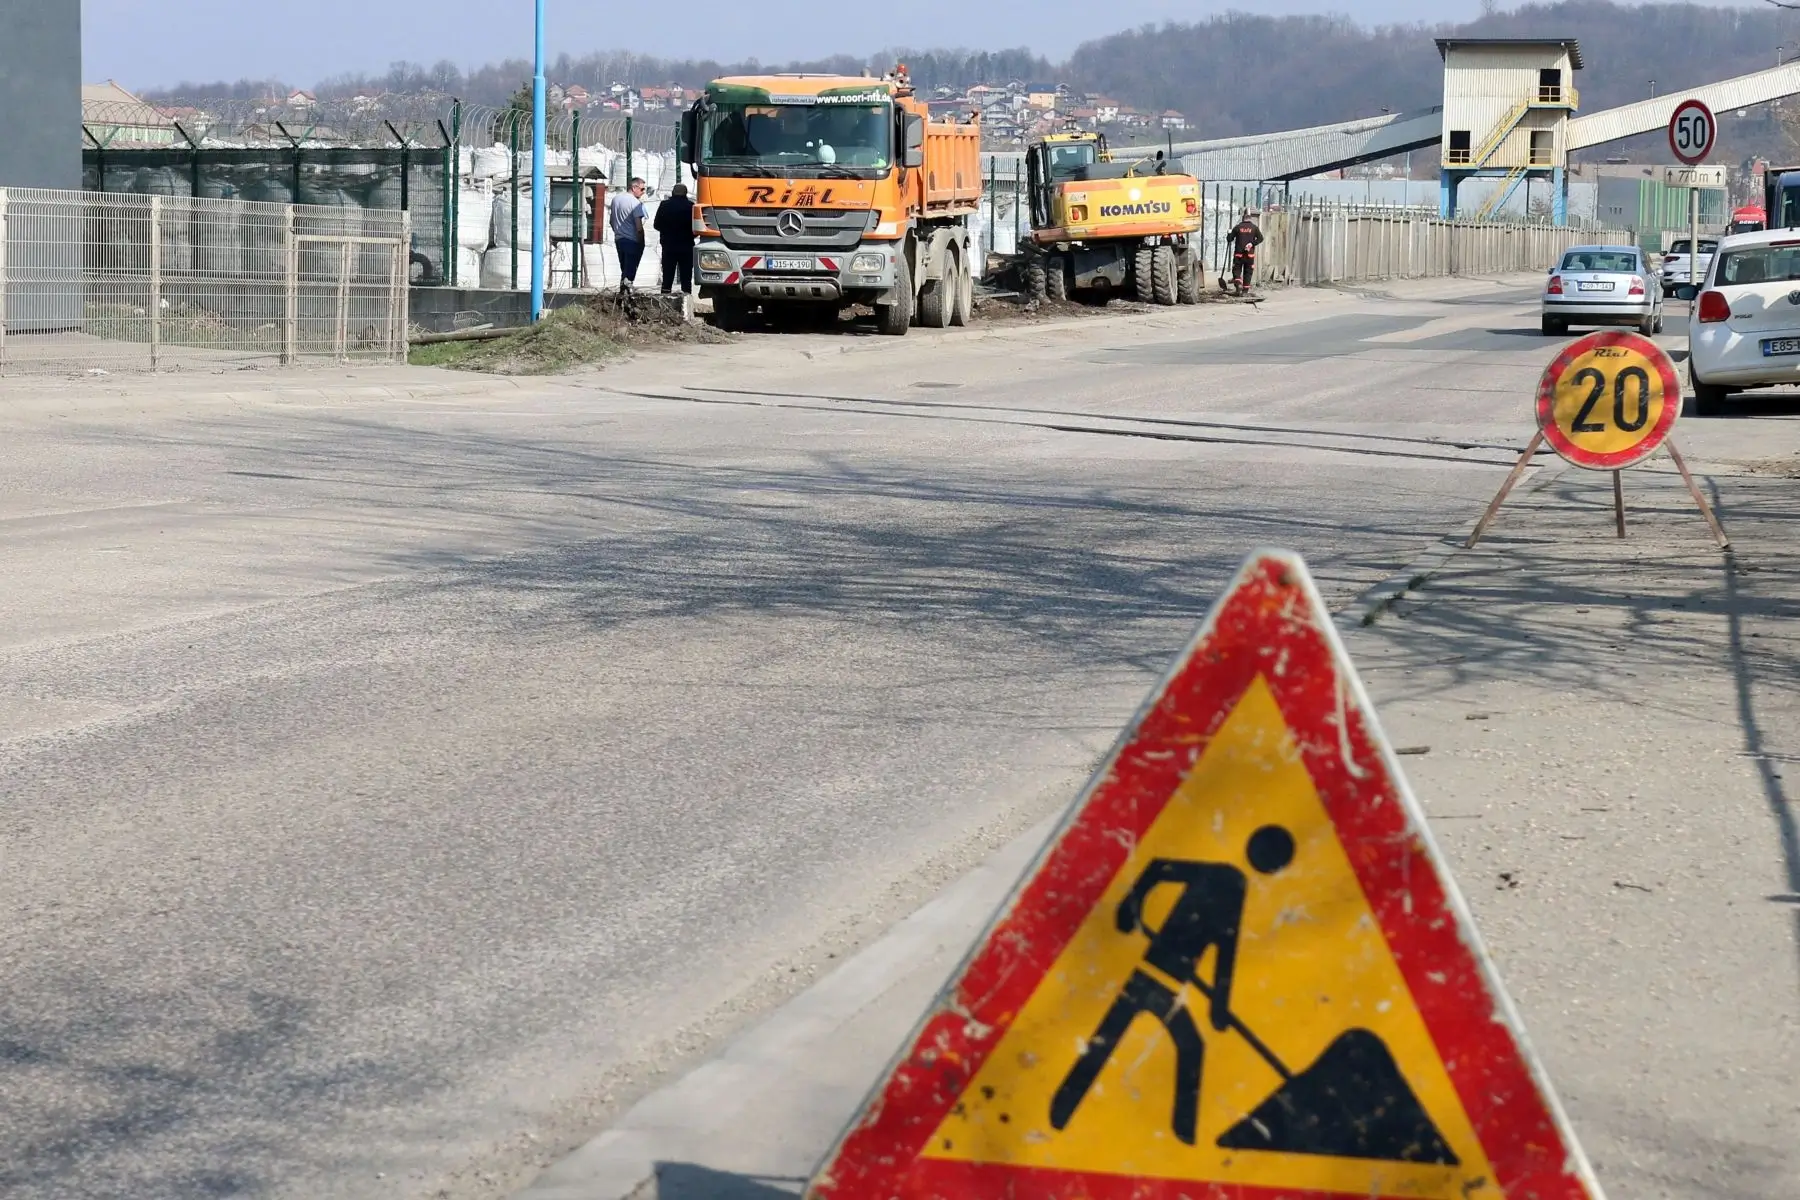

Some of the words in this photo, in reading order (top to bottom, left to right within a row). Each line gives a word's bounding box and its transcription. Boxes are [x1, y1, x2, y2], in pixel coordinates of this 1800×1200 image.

[1679, 116, 1705, 149] 50
[1678, 170, 1697, 182] 770
[1700, 173, 1708, 182] m
[1100, 200, 1171, 216] KOMATSU
[1771, 340, 1800, 352] E85-
[1572, 367, 1649, 432] 20
